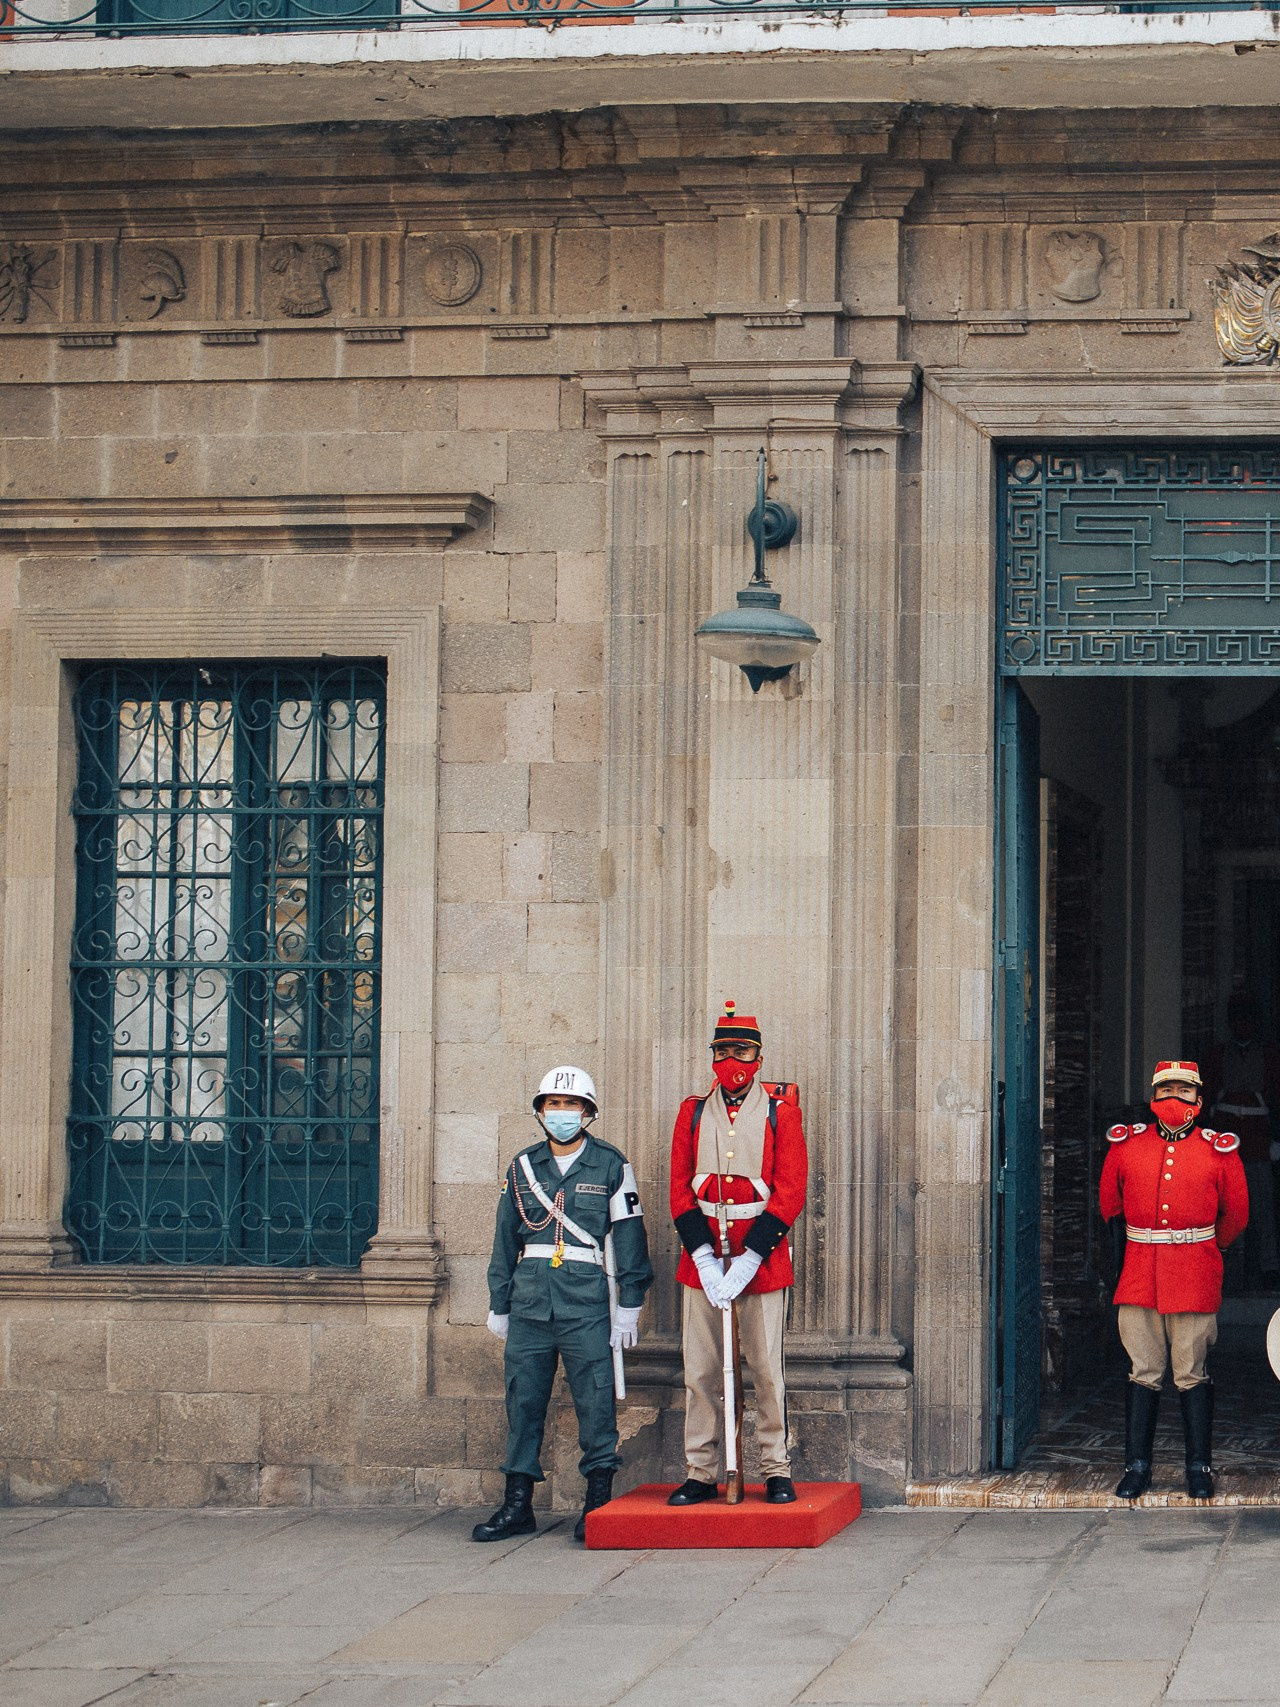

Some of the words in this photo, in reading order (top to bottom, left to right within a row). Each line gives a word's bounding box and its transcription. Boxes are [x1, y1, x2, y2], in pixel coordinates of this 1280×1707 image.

[553, 1072, 576, 1090] PM
[578, 1185, 608, 1193] EJERCIT
[624, 1191, 640, 1215] P
